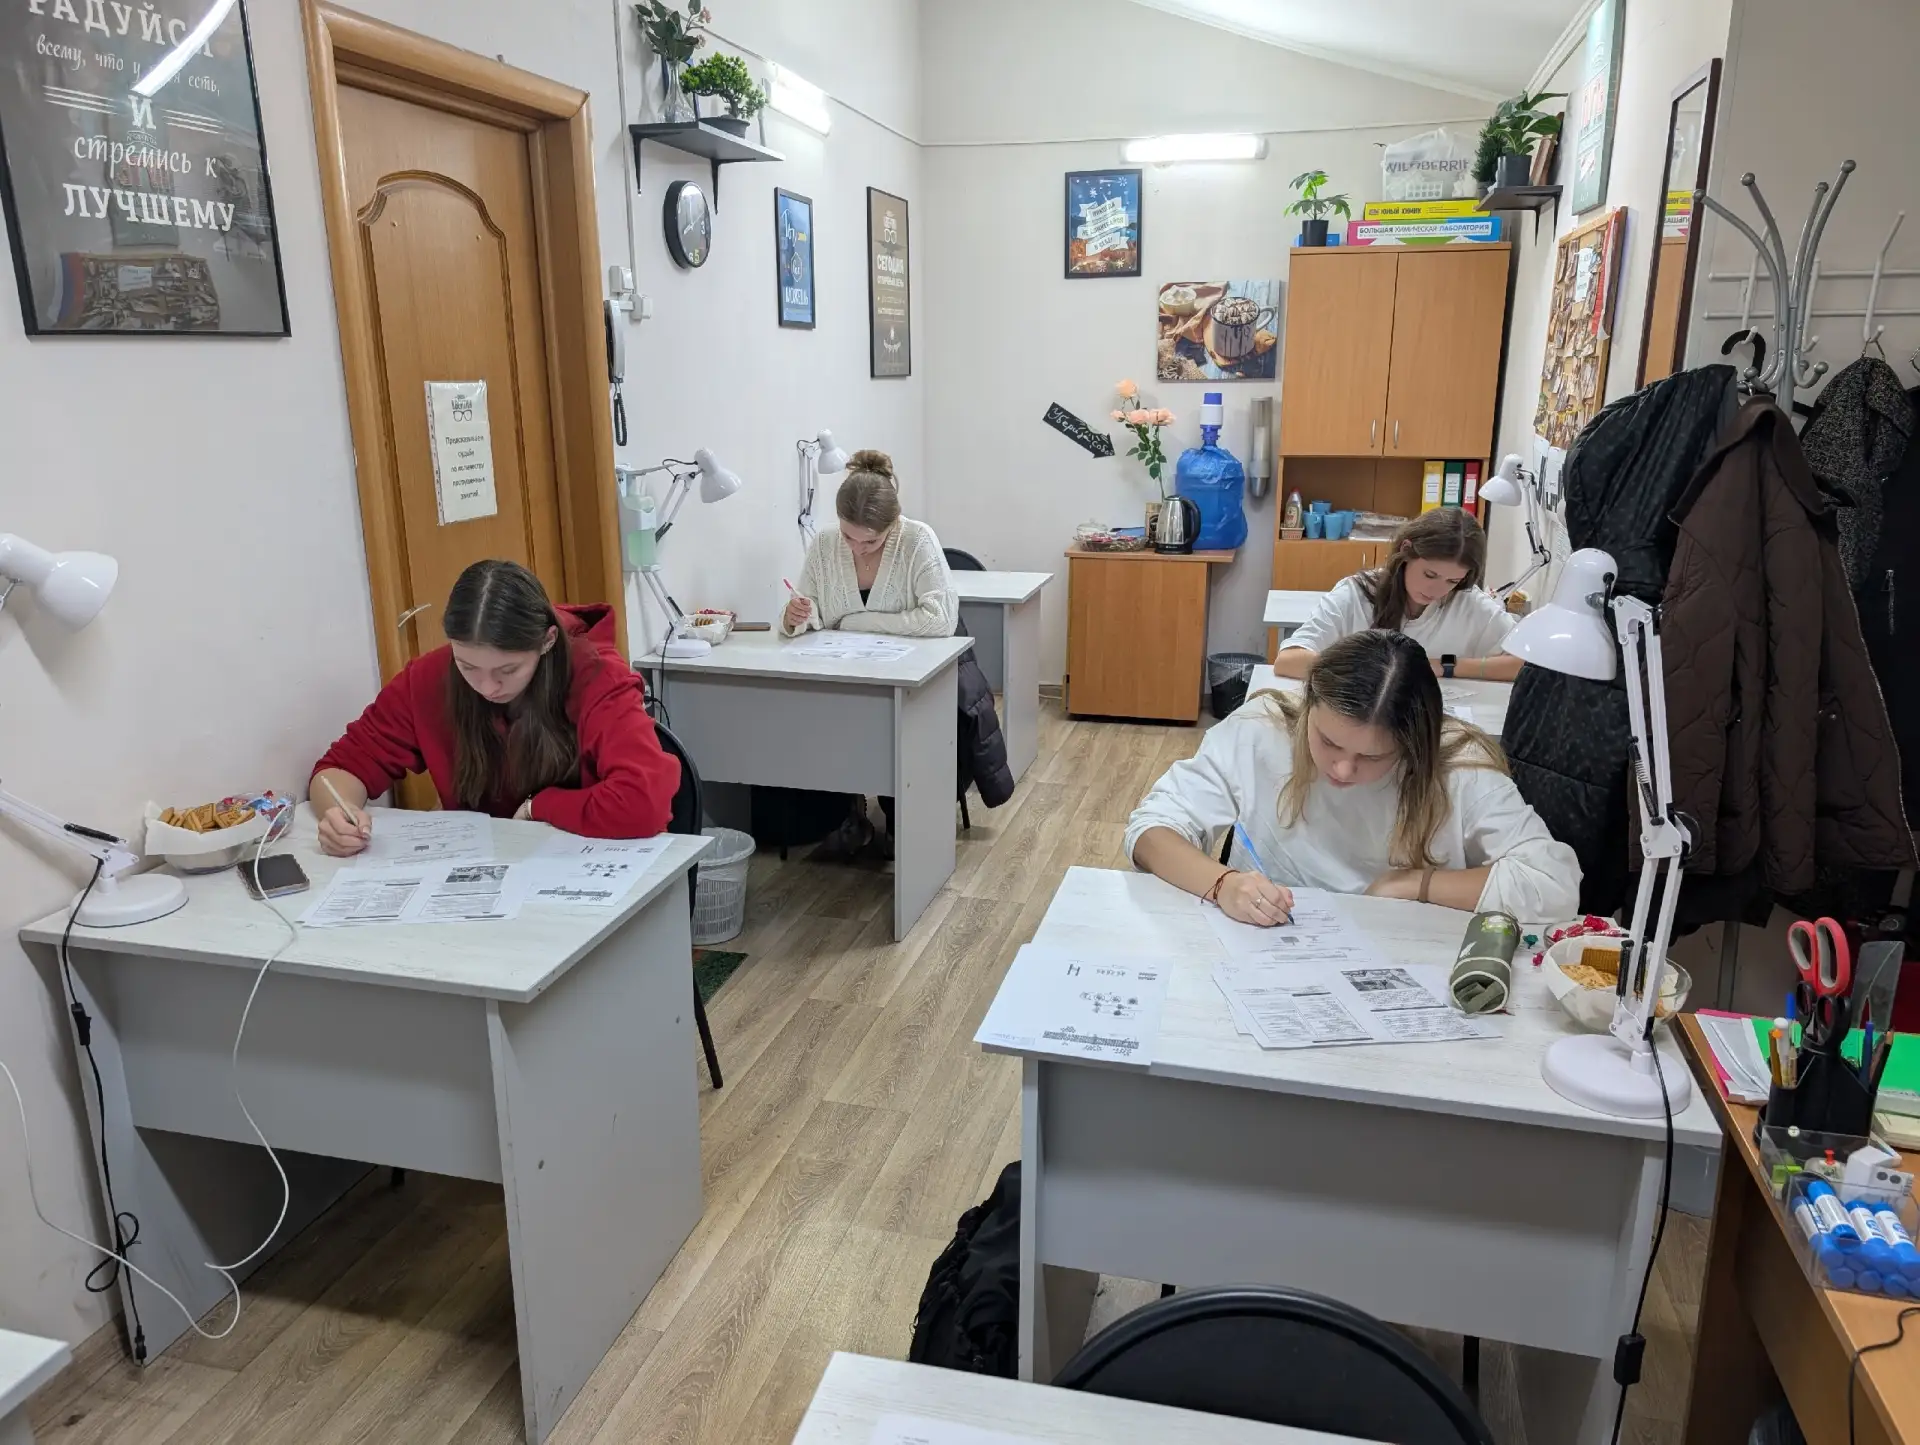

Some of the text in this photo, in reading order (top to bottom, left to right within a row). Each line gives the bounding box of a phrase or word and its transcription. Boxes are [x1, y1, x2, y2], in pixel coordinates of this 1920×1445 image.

[36, 33, 86, 71] всему,
[95, 53, 124, 71] что
[188, 74, 220, 97] есть,
[128, 95, 157, 130] И
[74, 135, 192, 179] стремись
[62, 183, 235, 232] ЛУЧШЕМУ
[1439, 224, 1490, 232] ЛАБОРАТОРИЯ
